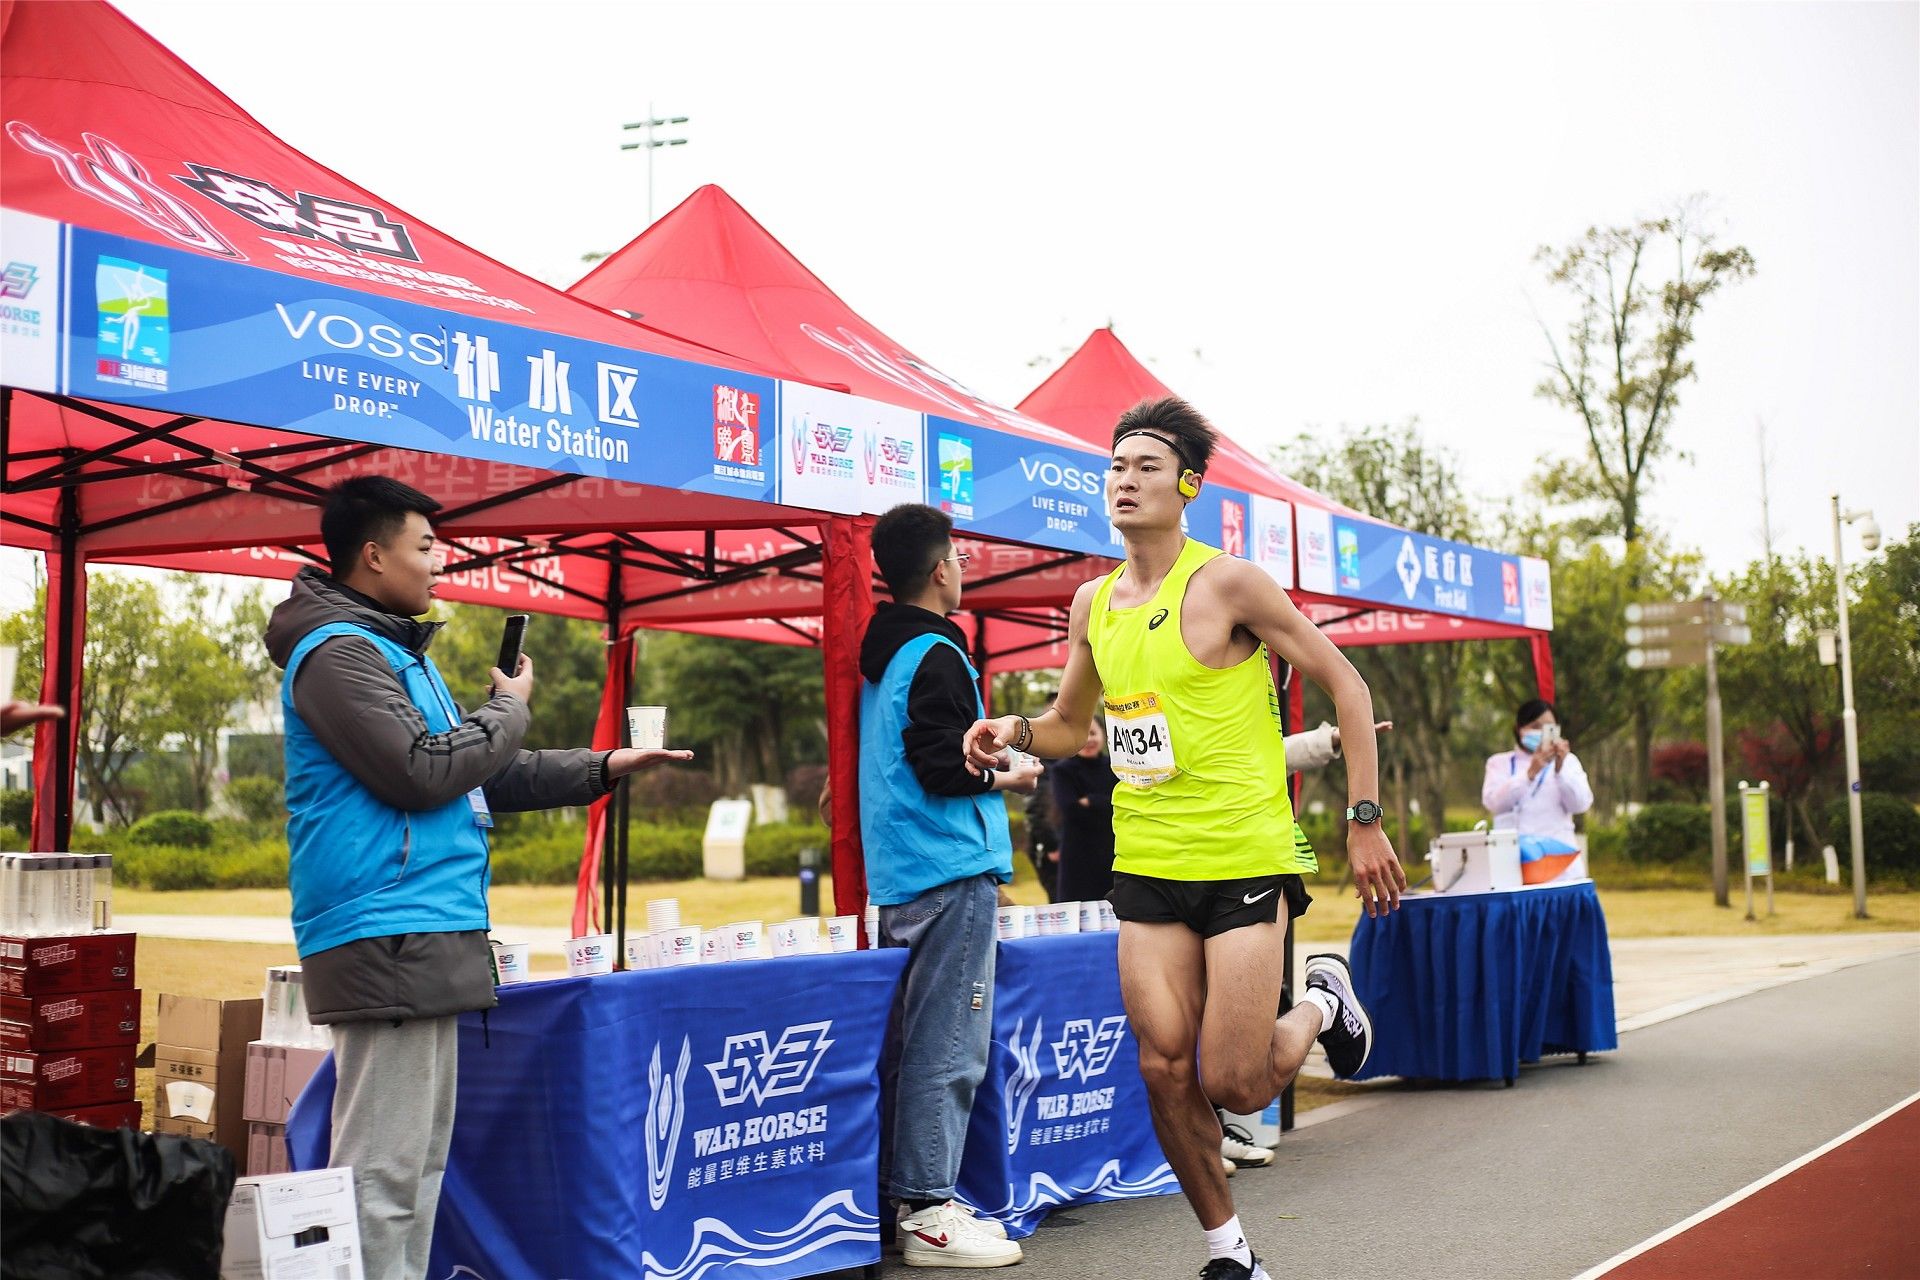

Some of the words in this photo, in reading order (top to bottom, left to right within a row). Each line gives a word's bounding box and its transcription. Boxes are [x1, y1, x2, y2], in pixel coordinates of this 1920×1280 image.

[0, 304, 40, 325] ORSE
[275, 302, 443, 366] VOSS
[302, 361, 348, 385] LIVE
[358, 371, 421, 398] EVERY
[452, 330, 640, 429] 补水区
[467, 404, 542, 449] Water
[546, 418, 629, 464] Station
[1019, 456, 1100, 495] VOSS
[1032, 495, 1055, 512] LIVE
[1058, 500, 1089, 518] EVERY
[1037, 1093, 1069, 1120] WAR
[1069, 1086, 1116, 1117] HORSE
[694, 1122, 741, 1158] WAR
[742, 1105, 828, 1147] HORSE
[687, 1140, 826, 1190] 能量型维生素饮料
